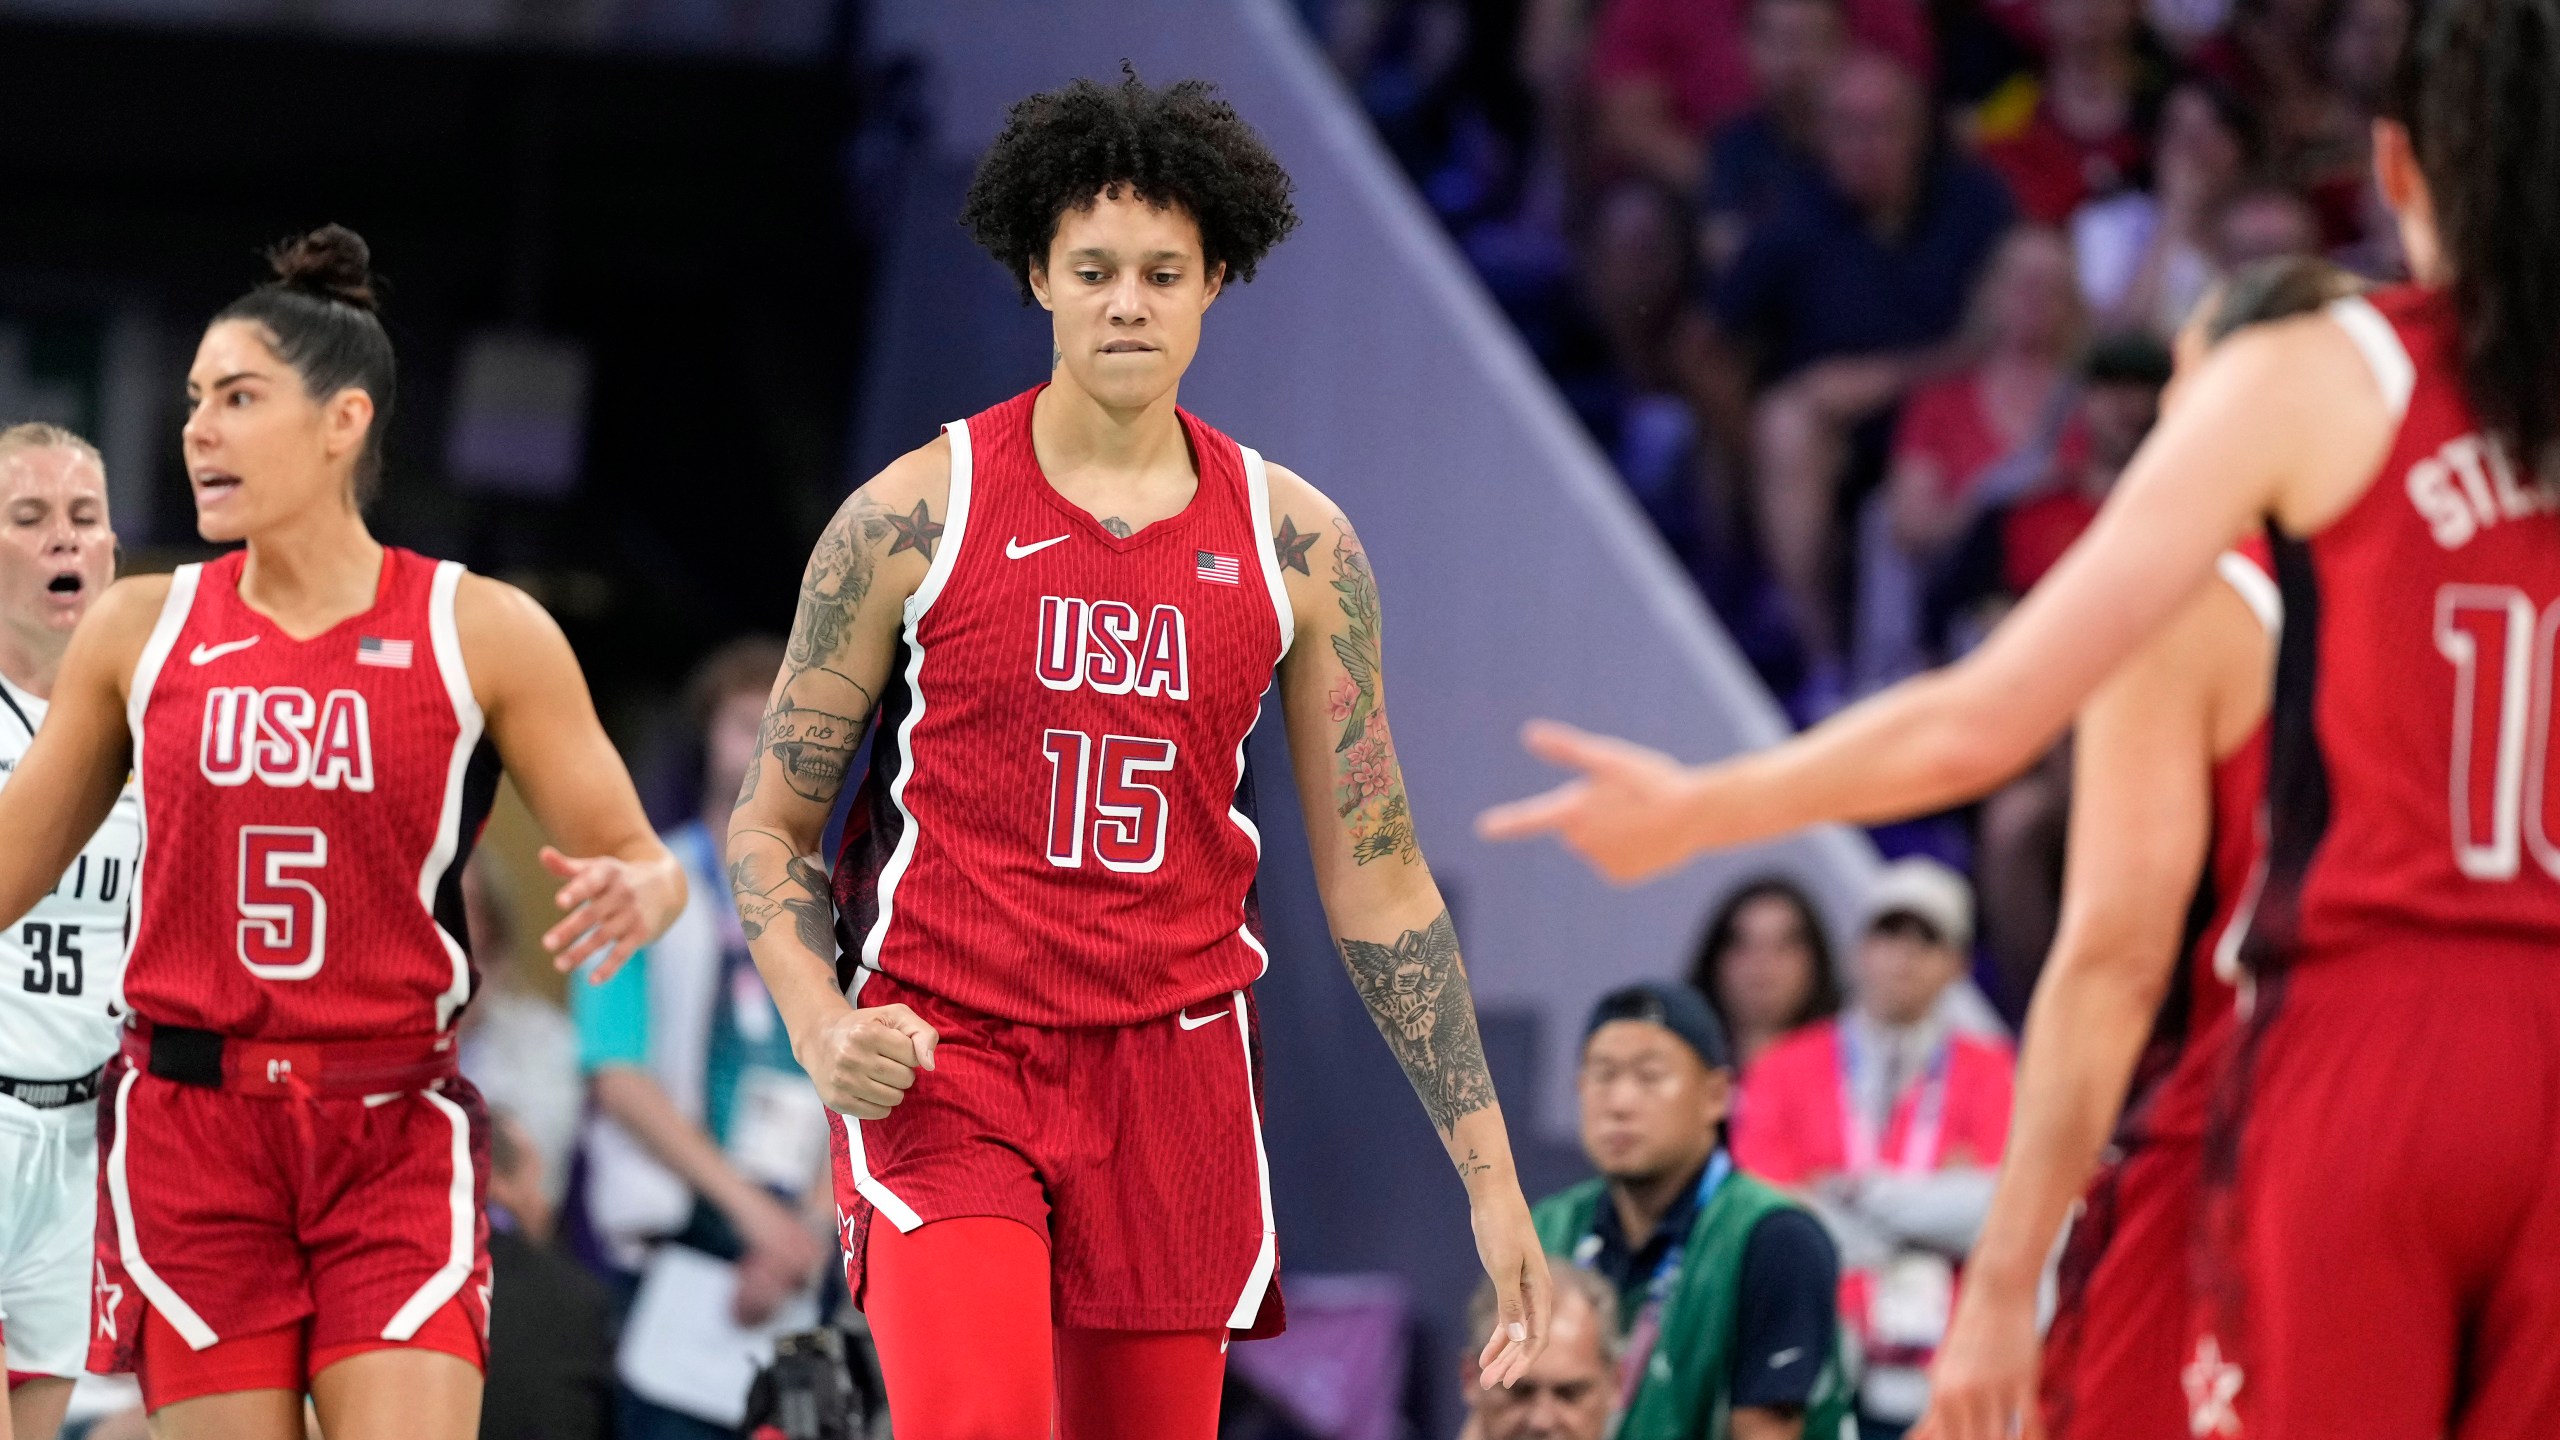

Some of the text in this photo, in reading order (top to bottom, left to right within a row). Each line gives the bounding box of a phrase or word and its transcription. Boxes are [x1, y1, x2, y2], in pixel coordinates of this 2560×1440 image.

[1036, 595, 1189, 701] USA
[199, 685, 374, 792] USA
[805, 723, 834, 740] no
[1044, 728, 1176, 872] 15
[50, 855, 138, 902] IU
[236, 825, 328, 980] 5
[23, 922, 83, 996] 35
